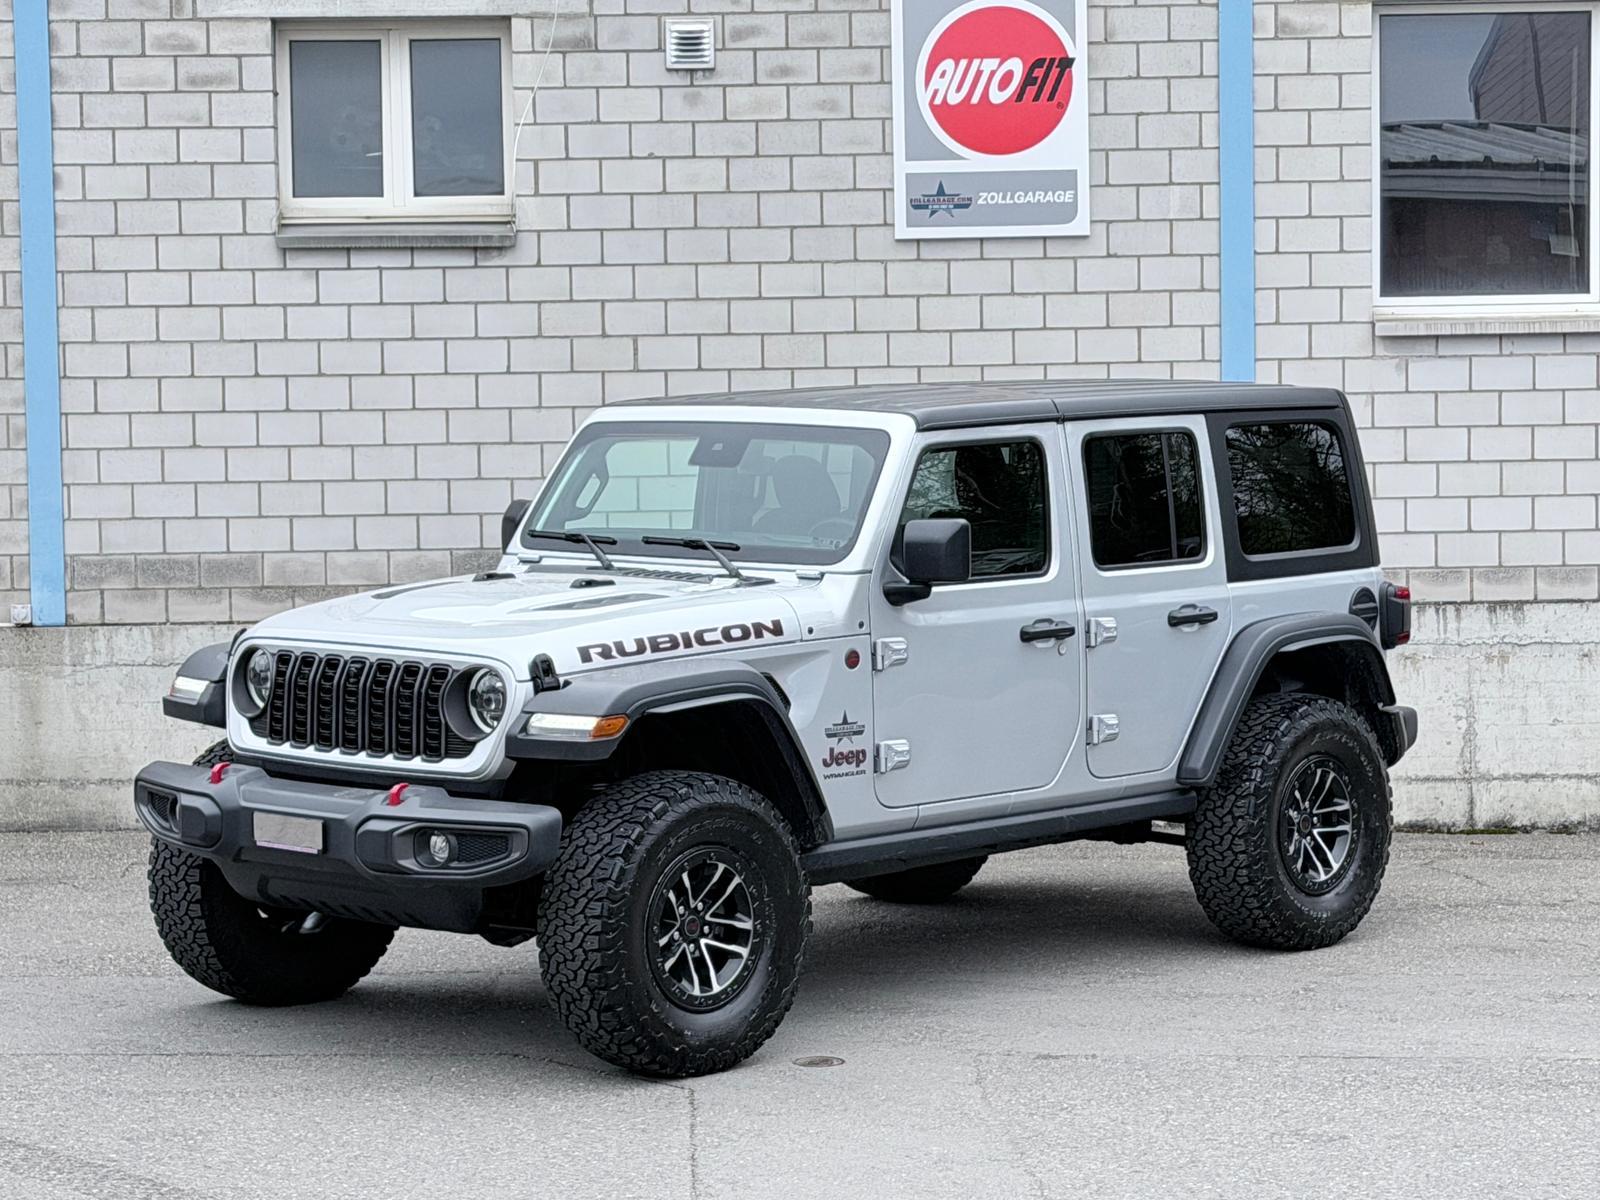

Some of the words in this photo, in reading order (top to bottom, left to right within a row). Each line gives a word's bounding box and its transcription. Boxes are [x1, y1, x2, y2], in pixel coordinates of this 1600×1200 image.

[977, 190, 1075, 204] ZOLLGARAGE
[576, 619, 784, 664] RUBICON
[822, 747, 867, 768] Jeep
[823, 769, 866, 780] WRANGLER
